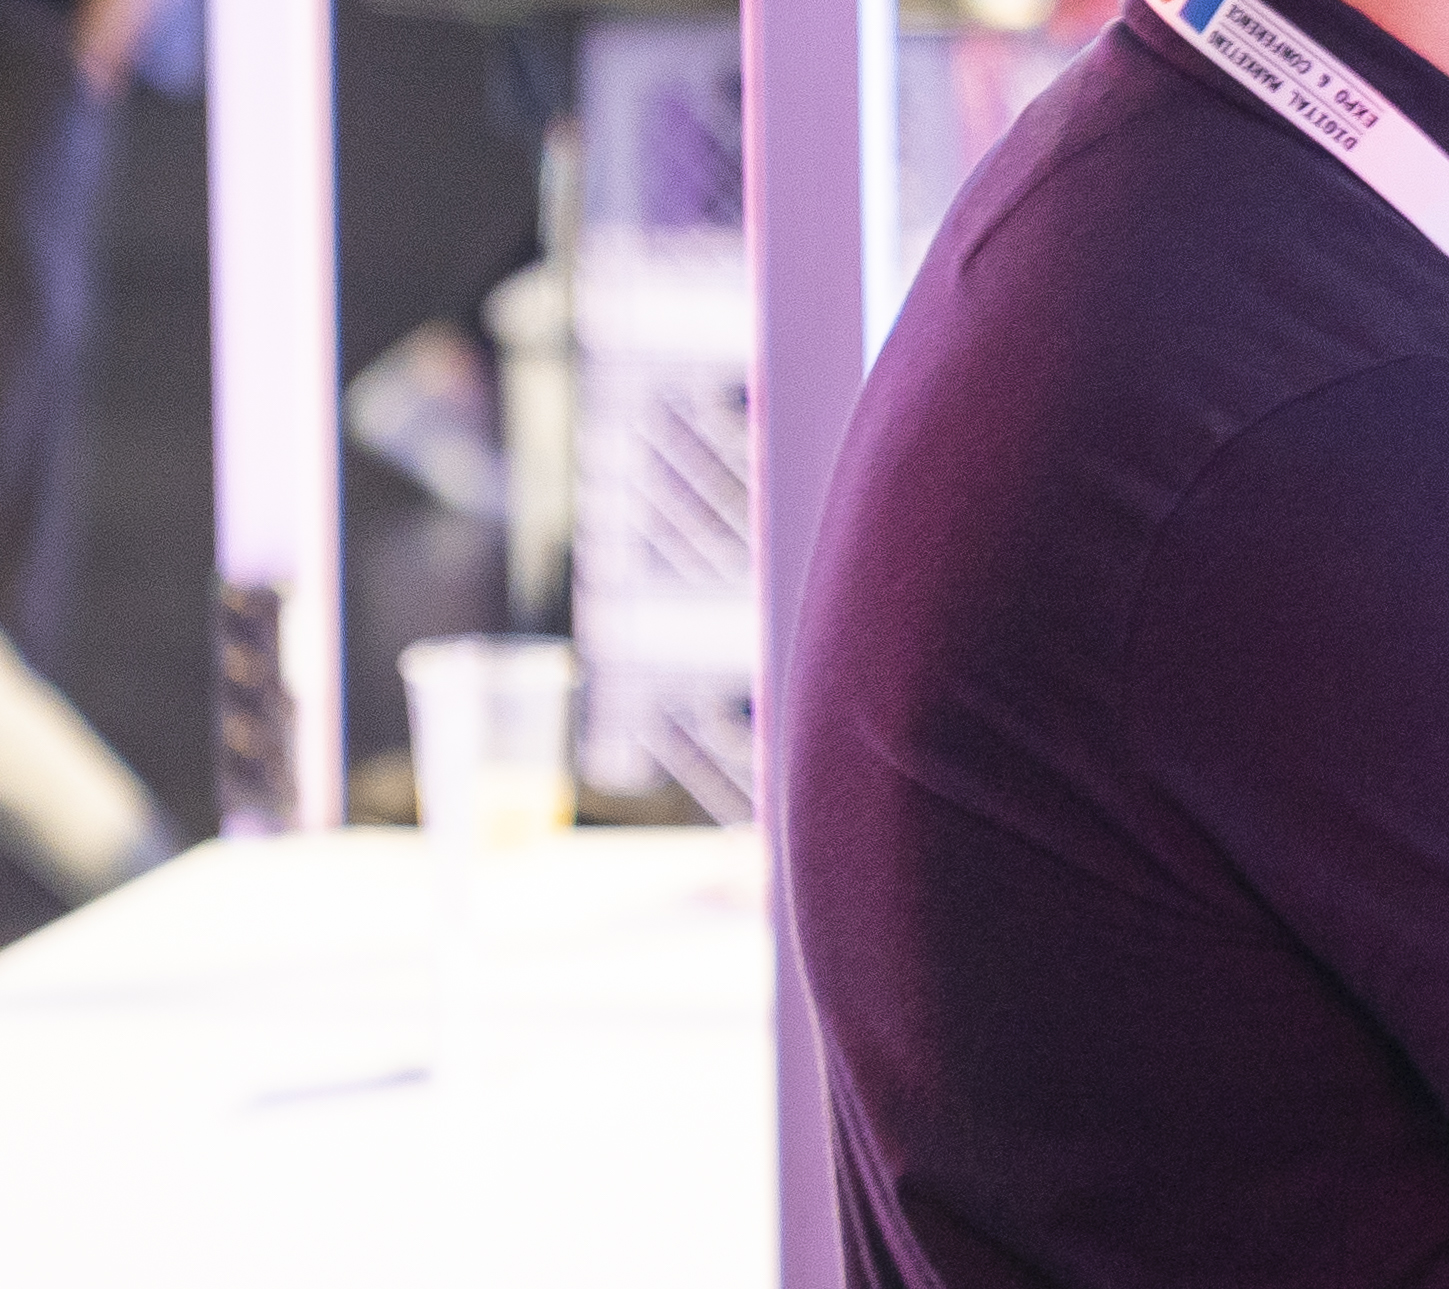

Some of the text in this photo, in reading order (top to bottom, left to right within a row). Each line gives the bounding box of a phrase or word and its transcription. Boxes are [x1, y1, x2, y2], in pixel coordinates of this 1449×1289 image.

[1226, 4, 1312, 74] CONFERENCE
[1207, 30, 1358, 151] DIGITAL MARKETING
[1334, 89, 1379, 128] EXPO
